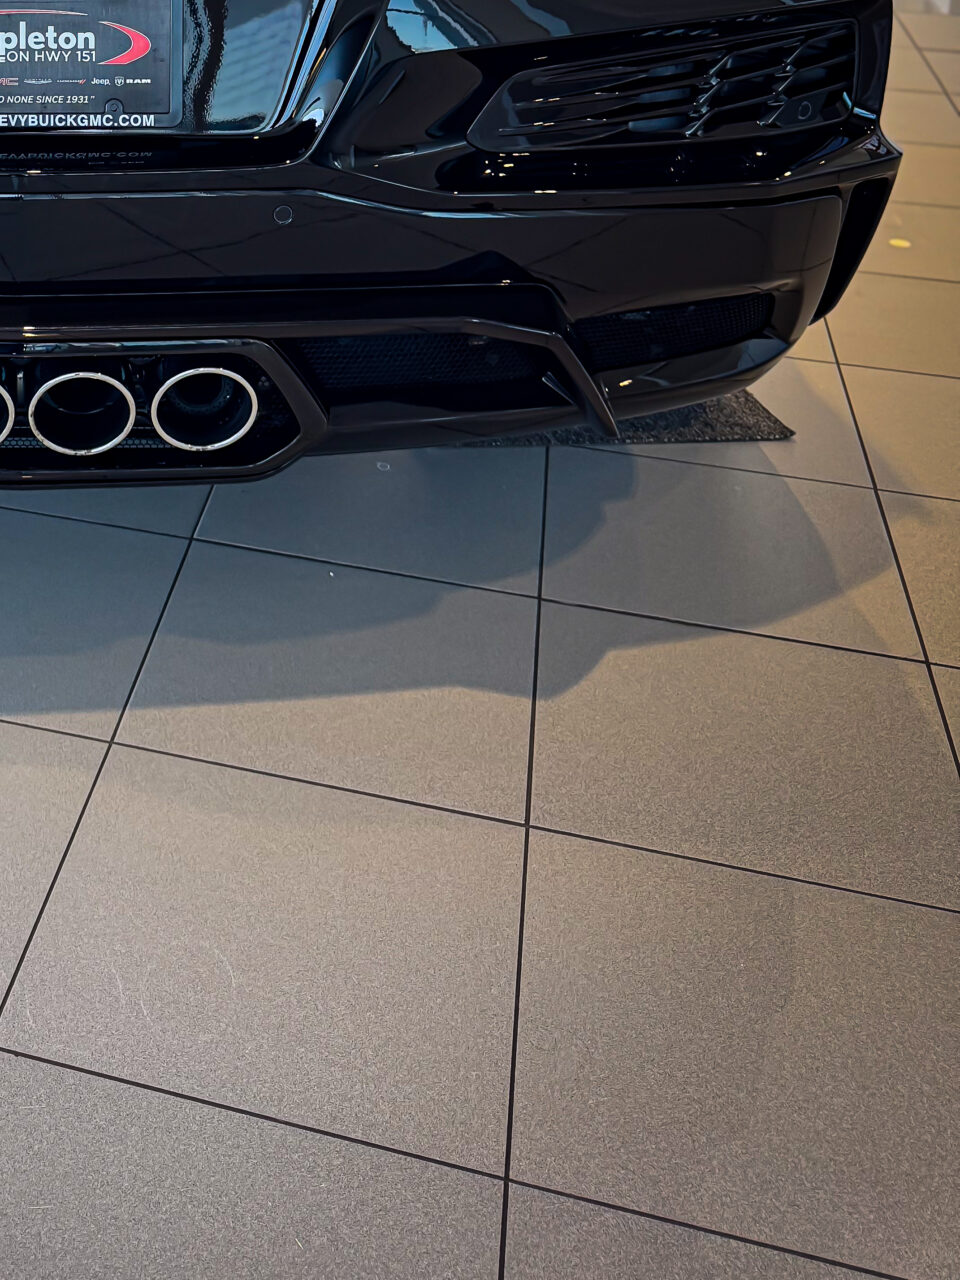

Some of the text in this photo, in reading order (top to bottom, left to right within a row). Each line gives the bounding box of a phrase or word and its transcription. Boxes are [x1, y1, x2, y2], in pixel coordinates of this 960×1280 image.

[6, 50, 96, 63] ON HWY 151
[6, 95, 34, 104] NONE
[35, 95, 64, 104] SINCE
